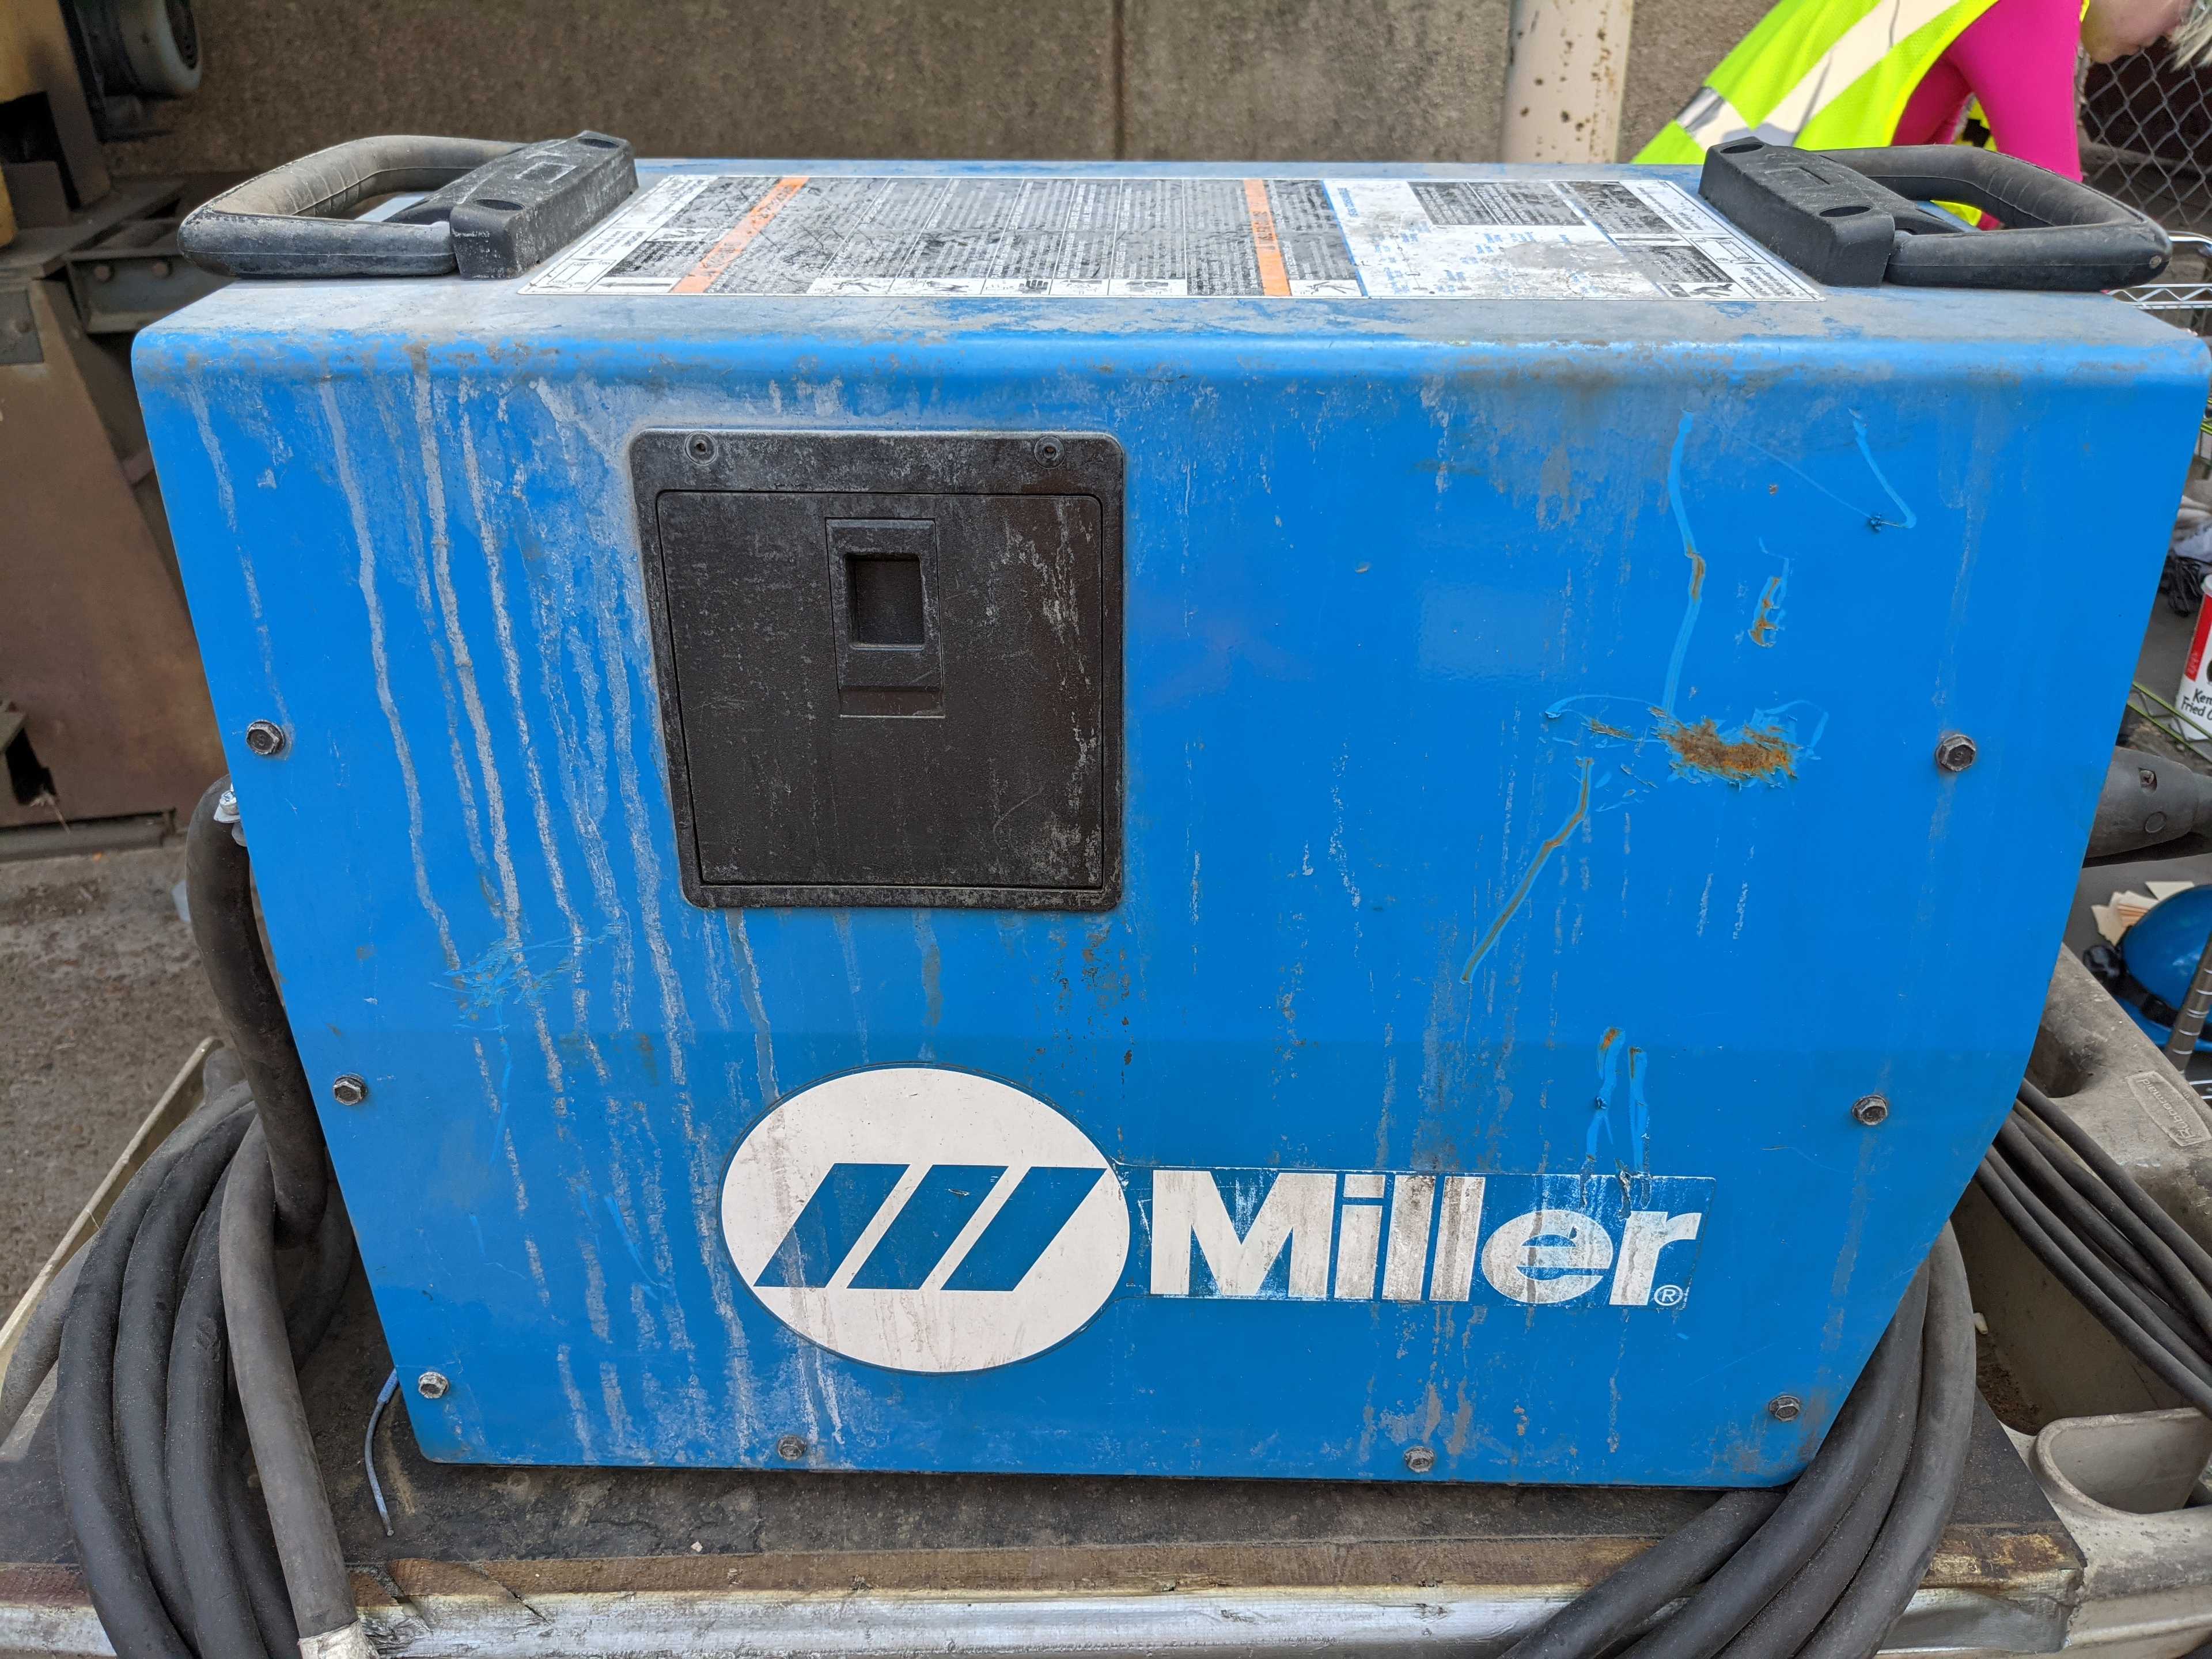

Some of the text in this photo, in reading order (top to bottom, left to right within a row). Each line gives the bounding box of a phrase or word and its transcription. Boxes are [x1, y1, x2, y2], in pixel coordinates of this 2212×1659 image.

[2181, 695, 2207, 717] Fried
[2136, 1078, 2196, 1139] Rubbermaid
[1150, 1169, 1703, 1306] Miller
